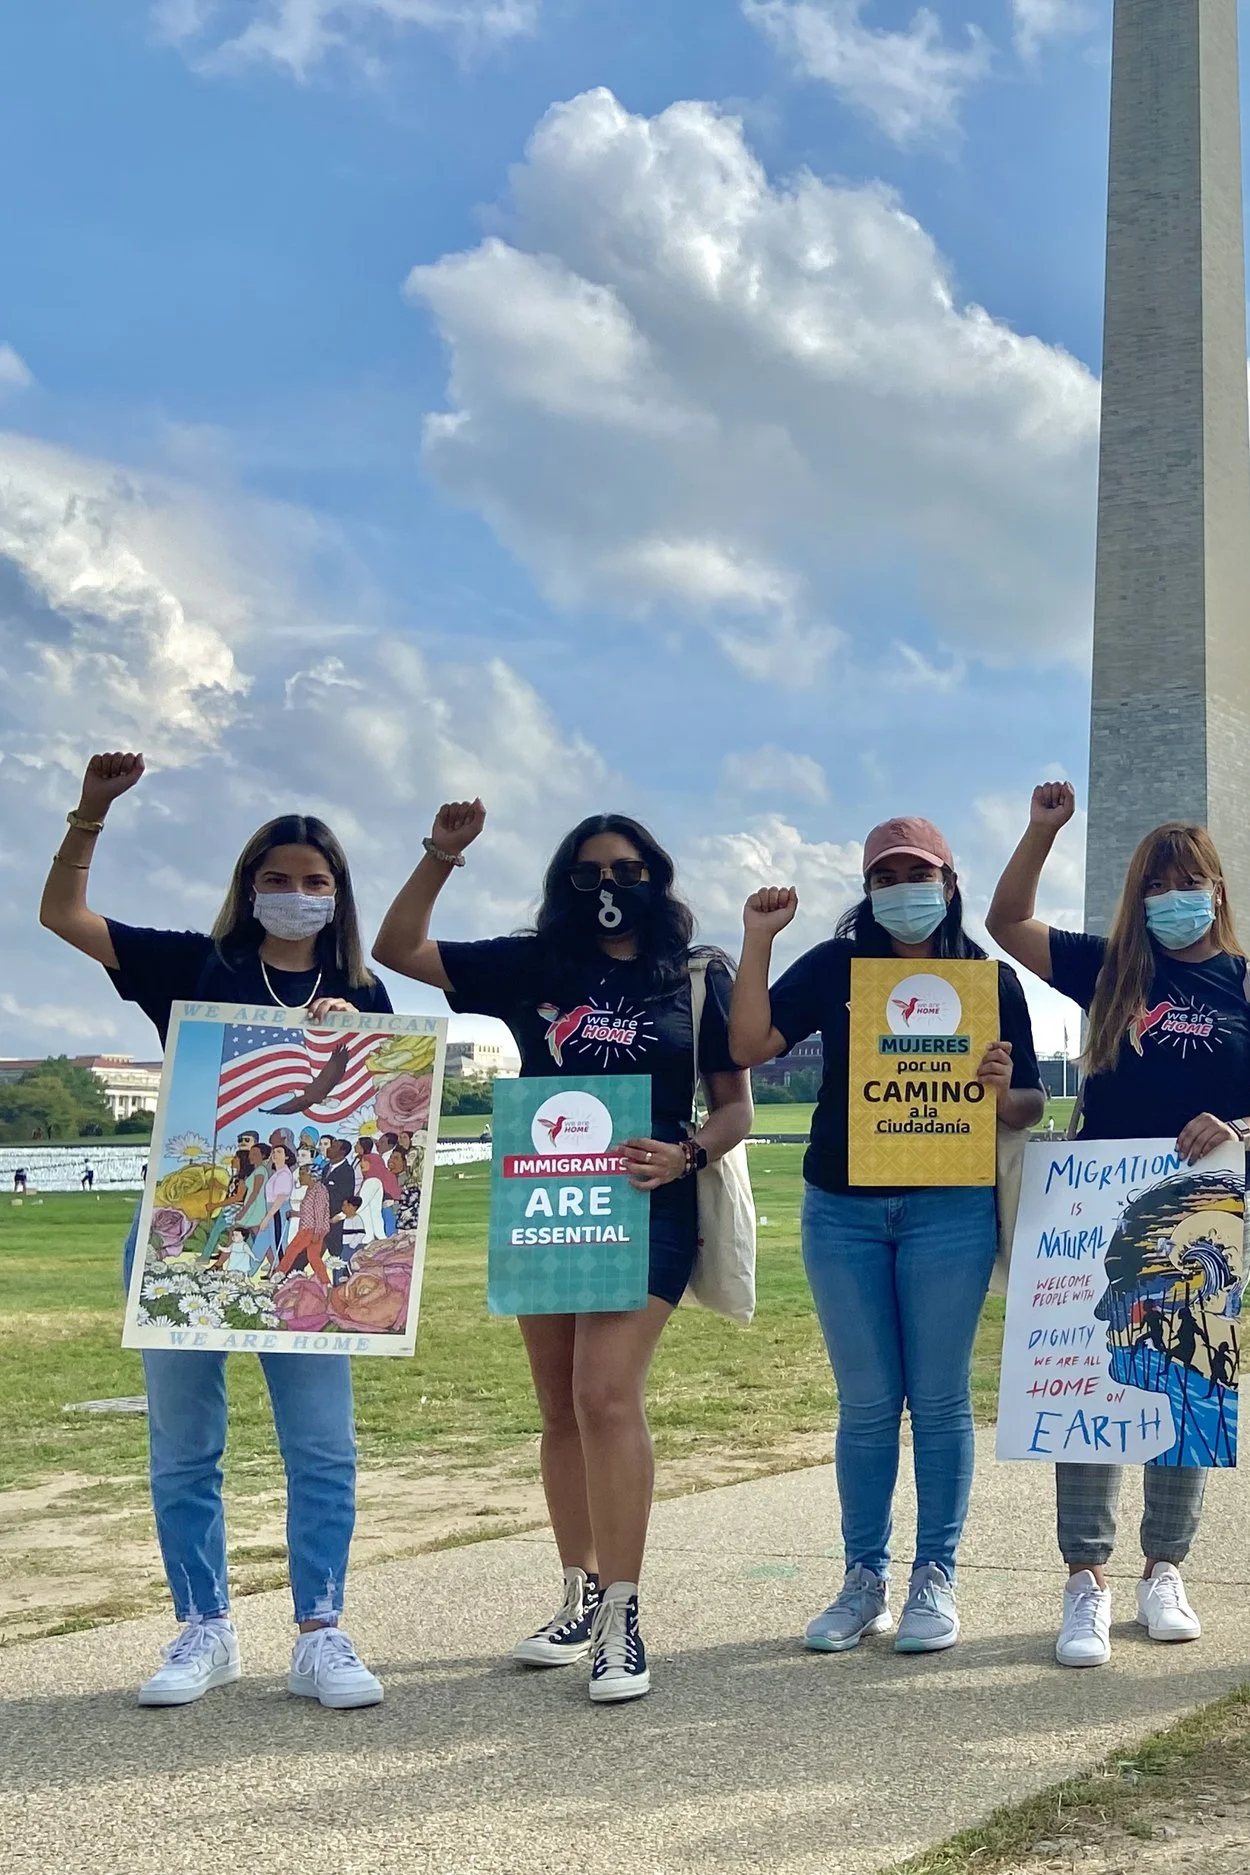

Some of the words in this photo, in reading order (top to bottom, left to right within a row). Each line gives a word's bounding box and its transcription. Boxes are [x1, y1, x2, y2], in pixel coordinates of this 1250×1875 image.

[183, 1003, 219, 1018] WE
[233, 1007, 286, 1022] ARE
[1167, 1012, 1188, 1022] we
[1190, 1013, 1213, 1024] are
[587, 1016, 609, 1026] we
[613, 1018, 638, 1030] are
[1161, 1020, 1214, 1037] HOME
[581, 1024, 637, 1045] HOME
[881, 1038, 969, 1053] MUJERES
[897, 1060, 926, 1075] por
[931, 1061, 952, 1072] un
[863, 1080, 985, 1103] CAMINO
[909, 1107, 920, 1118] a
[923, 1104, 938, 1118] la
[876, 1118, 971, 1134] Ciudadanía
[1045, 1154, 1181, 1194] MIGRATION
[524, 1186, 613, 1218] ARE
[1070, 1202, 1082, 1216] IS
[511, 1225, 631, 1245] ESSENTIAL
[1037, 1225, 1108, 1260] NATURAL
[1036, 1274, 1093, 1290] WELCOME
[1032, 1291, 1071, 1308] PEOPLE
[1072, 1289, 1095, 1303] WITH
[168, 1331, 208, 1346] WE
[224, 1334, 277, 1348] ARE
[293, 1336, 371, 1351] HOME
[1028, 1324, 1096, 1350] DIGNITY
[1034, 1356, 1052, 1366] WE
[1056, 1356, 1078, 1367] ARE
[1083, 1354, 1101, 1366] ALL
[1026, 1376, 1100, 1398] HOME
[1107, 1389, 1126, 1403] ON
[1027, 1407, 1161, 1454] EARTH
